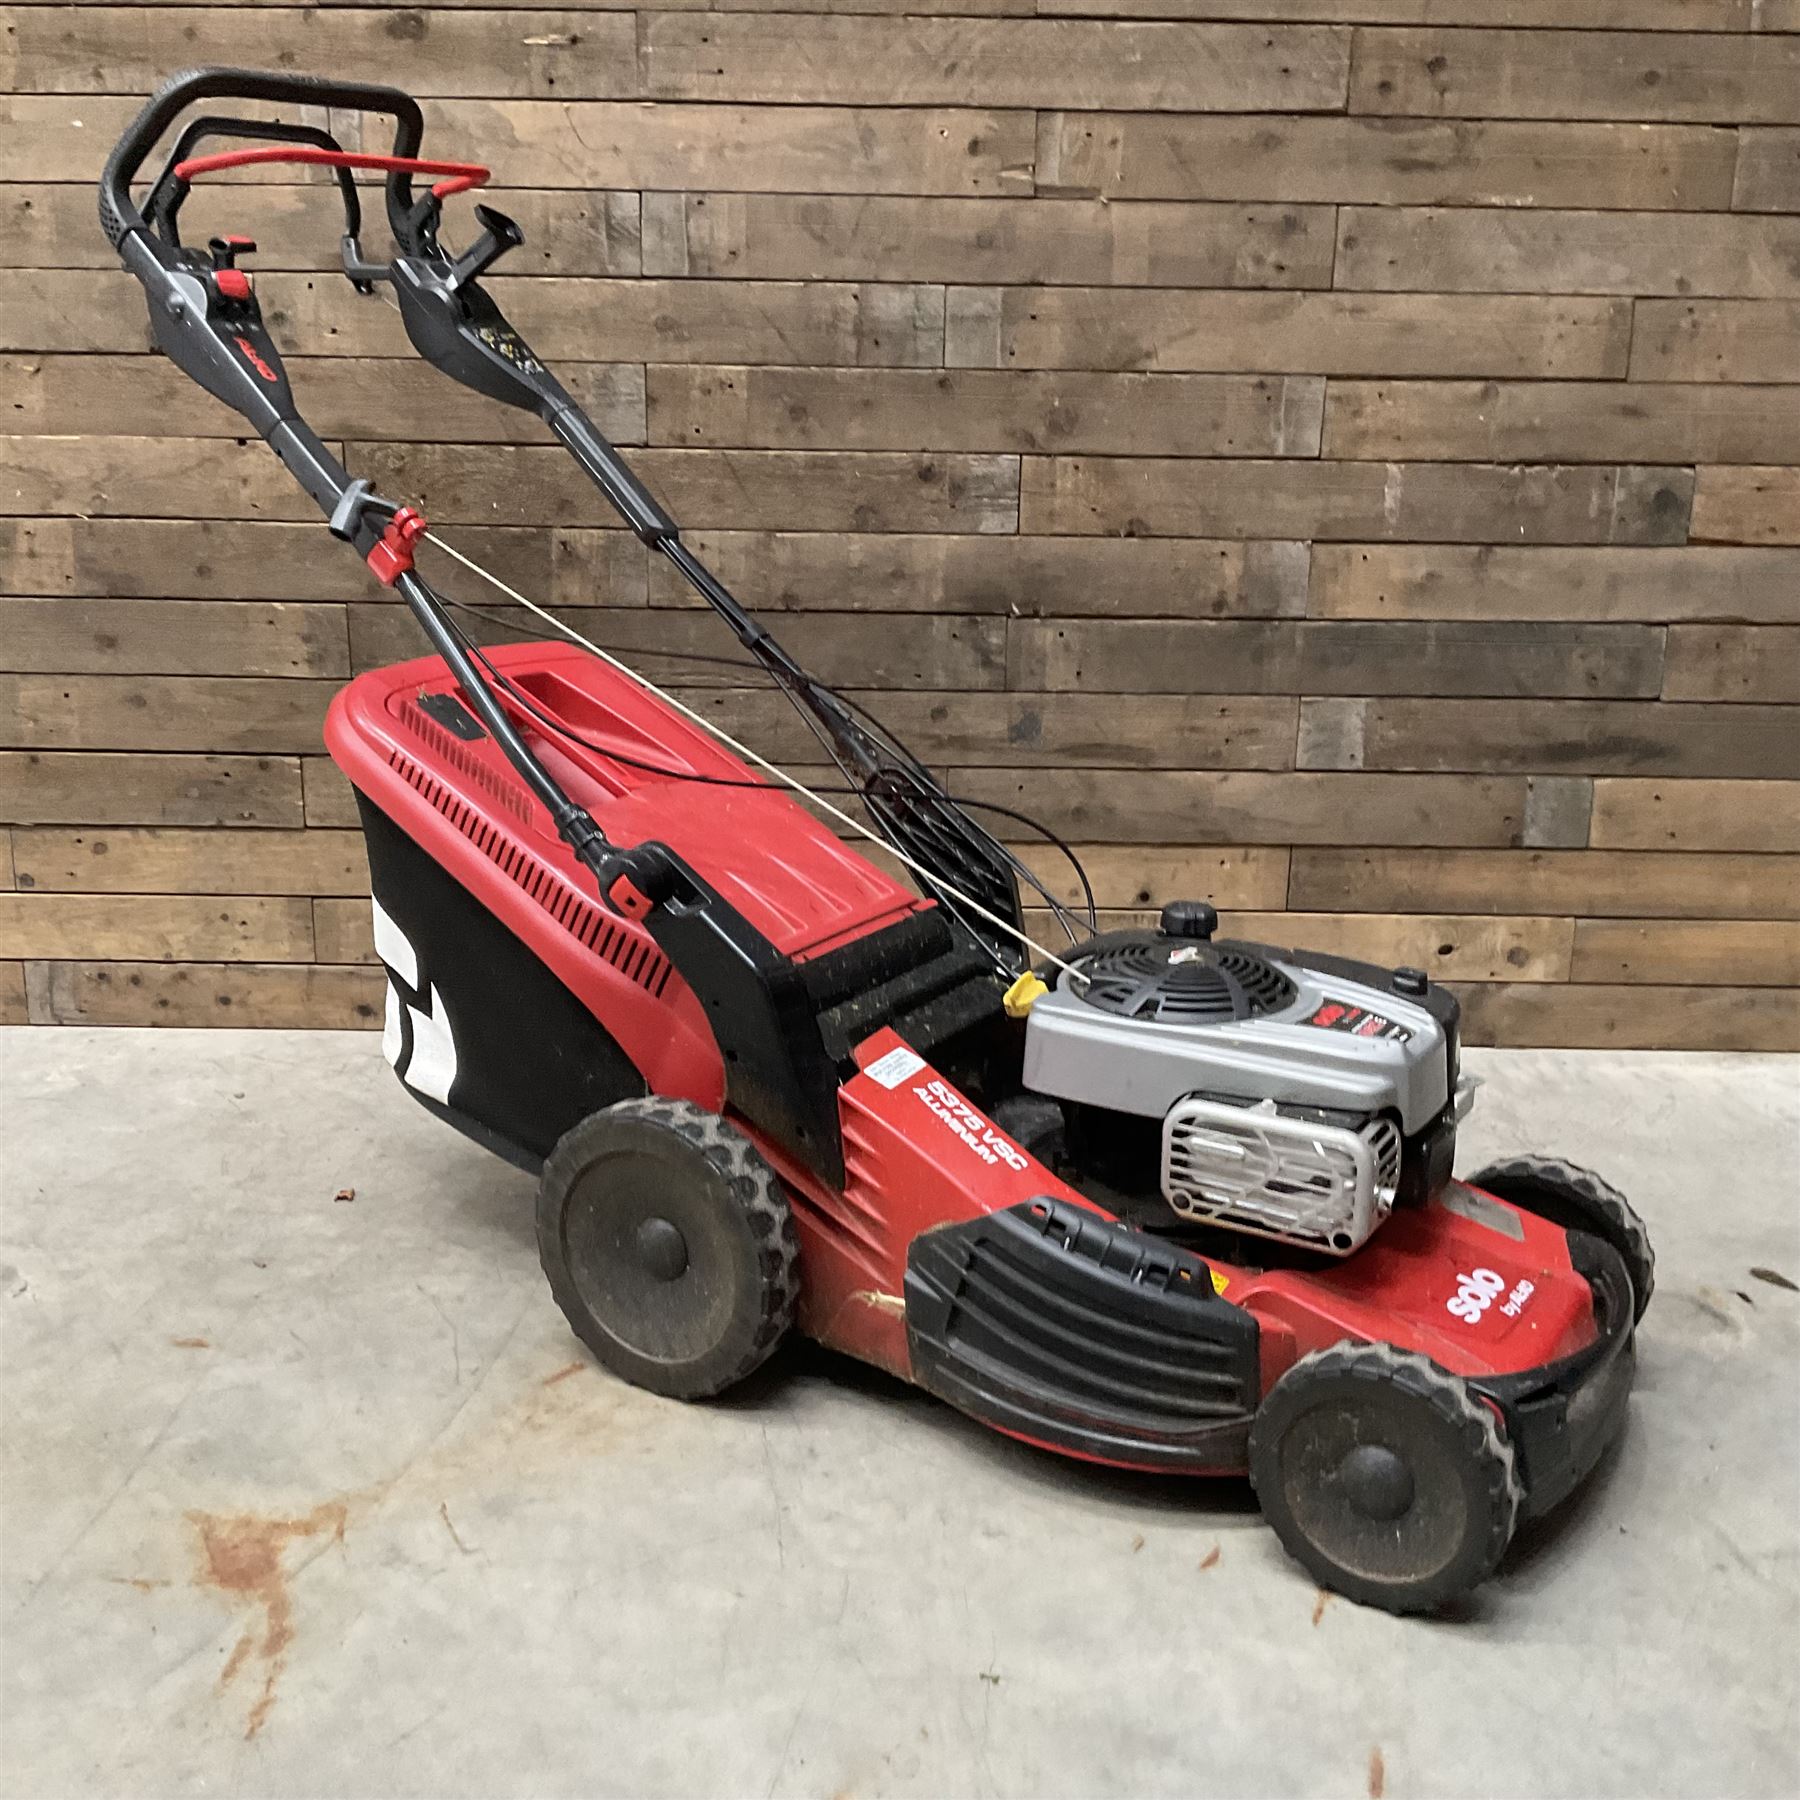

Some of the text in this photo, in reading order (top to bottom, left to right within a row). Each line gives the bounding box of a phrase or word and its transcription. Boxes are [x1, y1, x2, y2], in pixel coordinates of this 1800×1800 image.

[912, 1087, 999, 1165] ALUMINIUM
[927, 1080, 1028, 1171] 5375 VSC
[1446, 1268, 1505, 1324] solo
